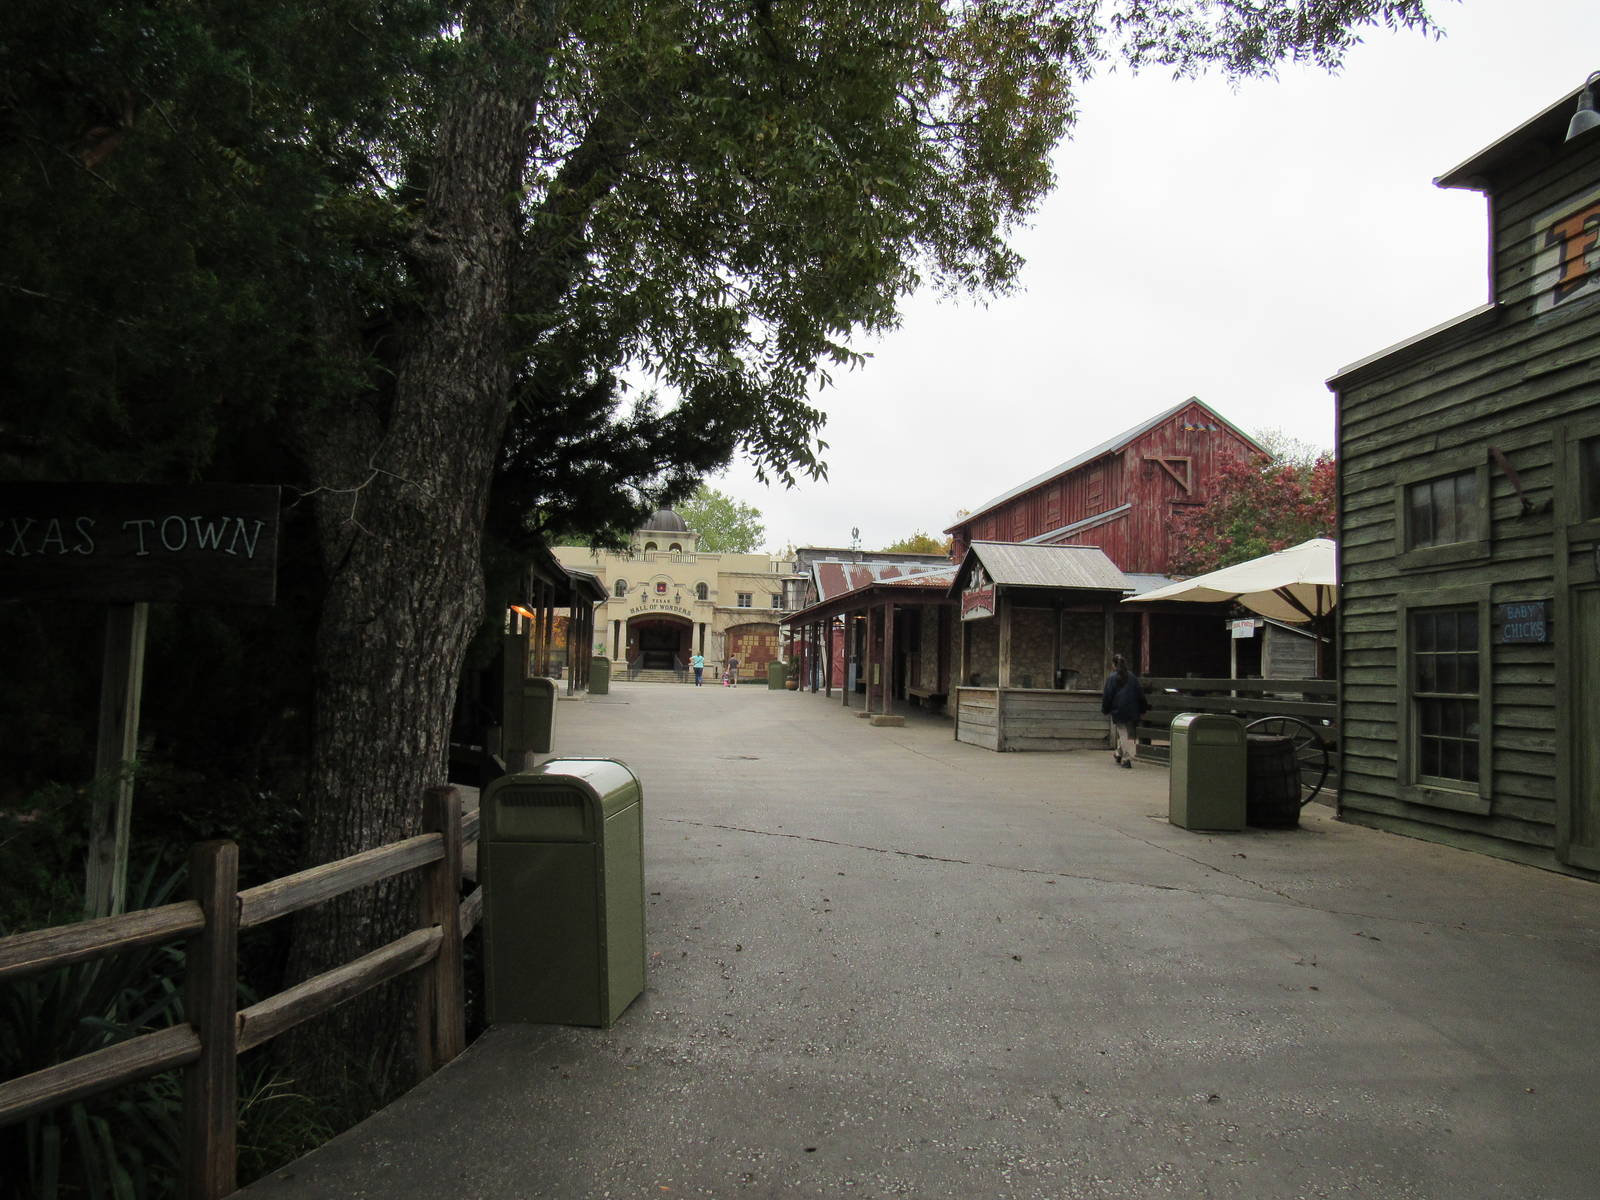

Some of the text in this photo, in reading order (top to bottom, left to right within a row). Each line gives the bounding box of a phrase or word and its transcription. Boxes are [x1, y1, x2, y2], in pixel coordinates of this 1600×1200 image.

[0, 514, 266, 559] XAS TOWN
[630, 604, 648, 614] HALL
[659, 604, 692, 616] WONDERS
[1507, 605, 1537, 619] BABY
[1504, 622, 1545, 639] CHICKS
